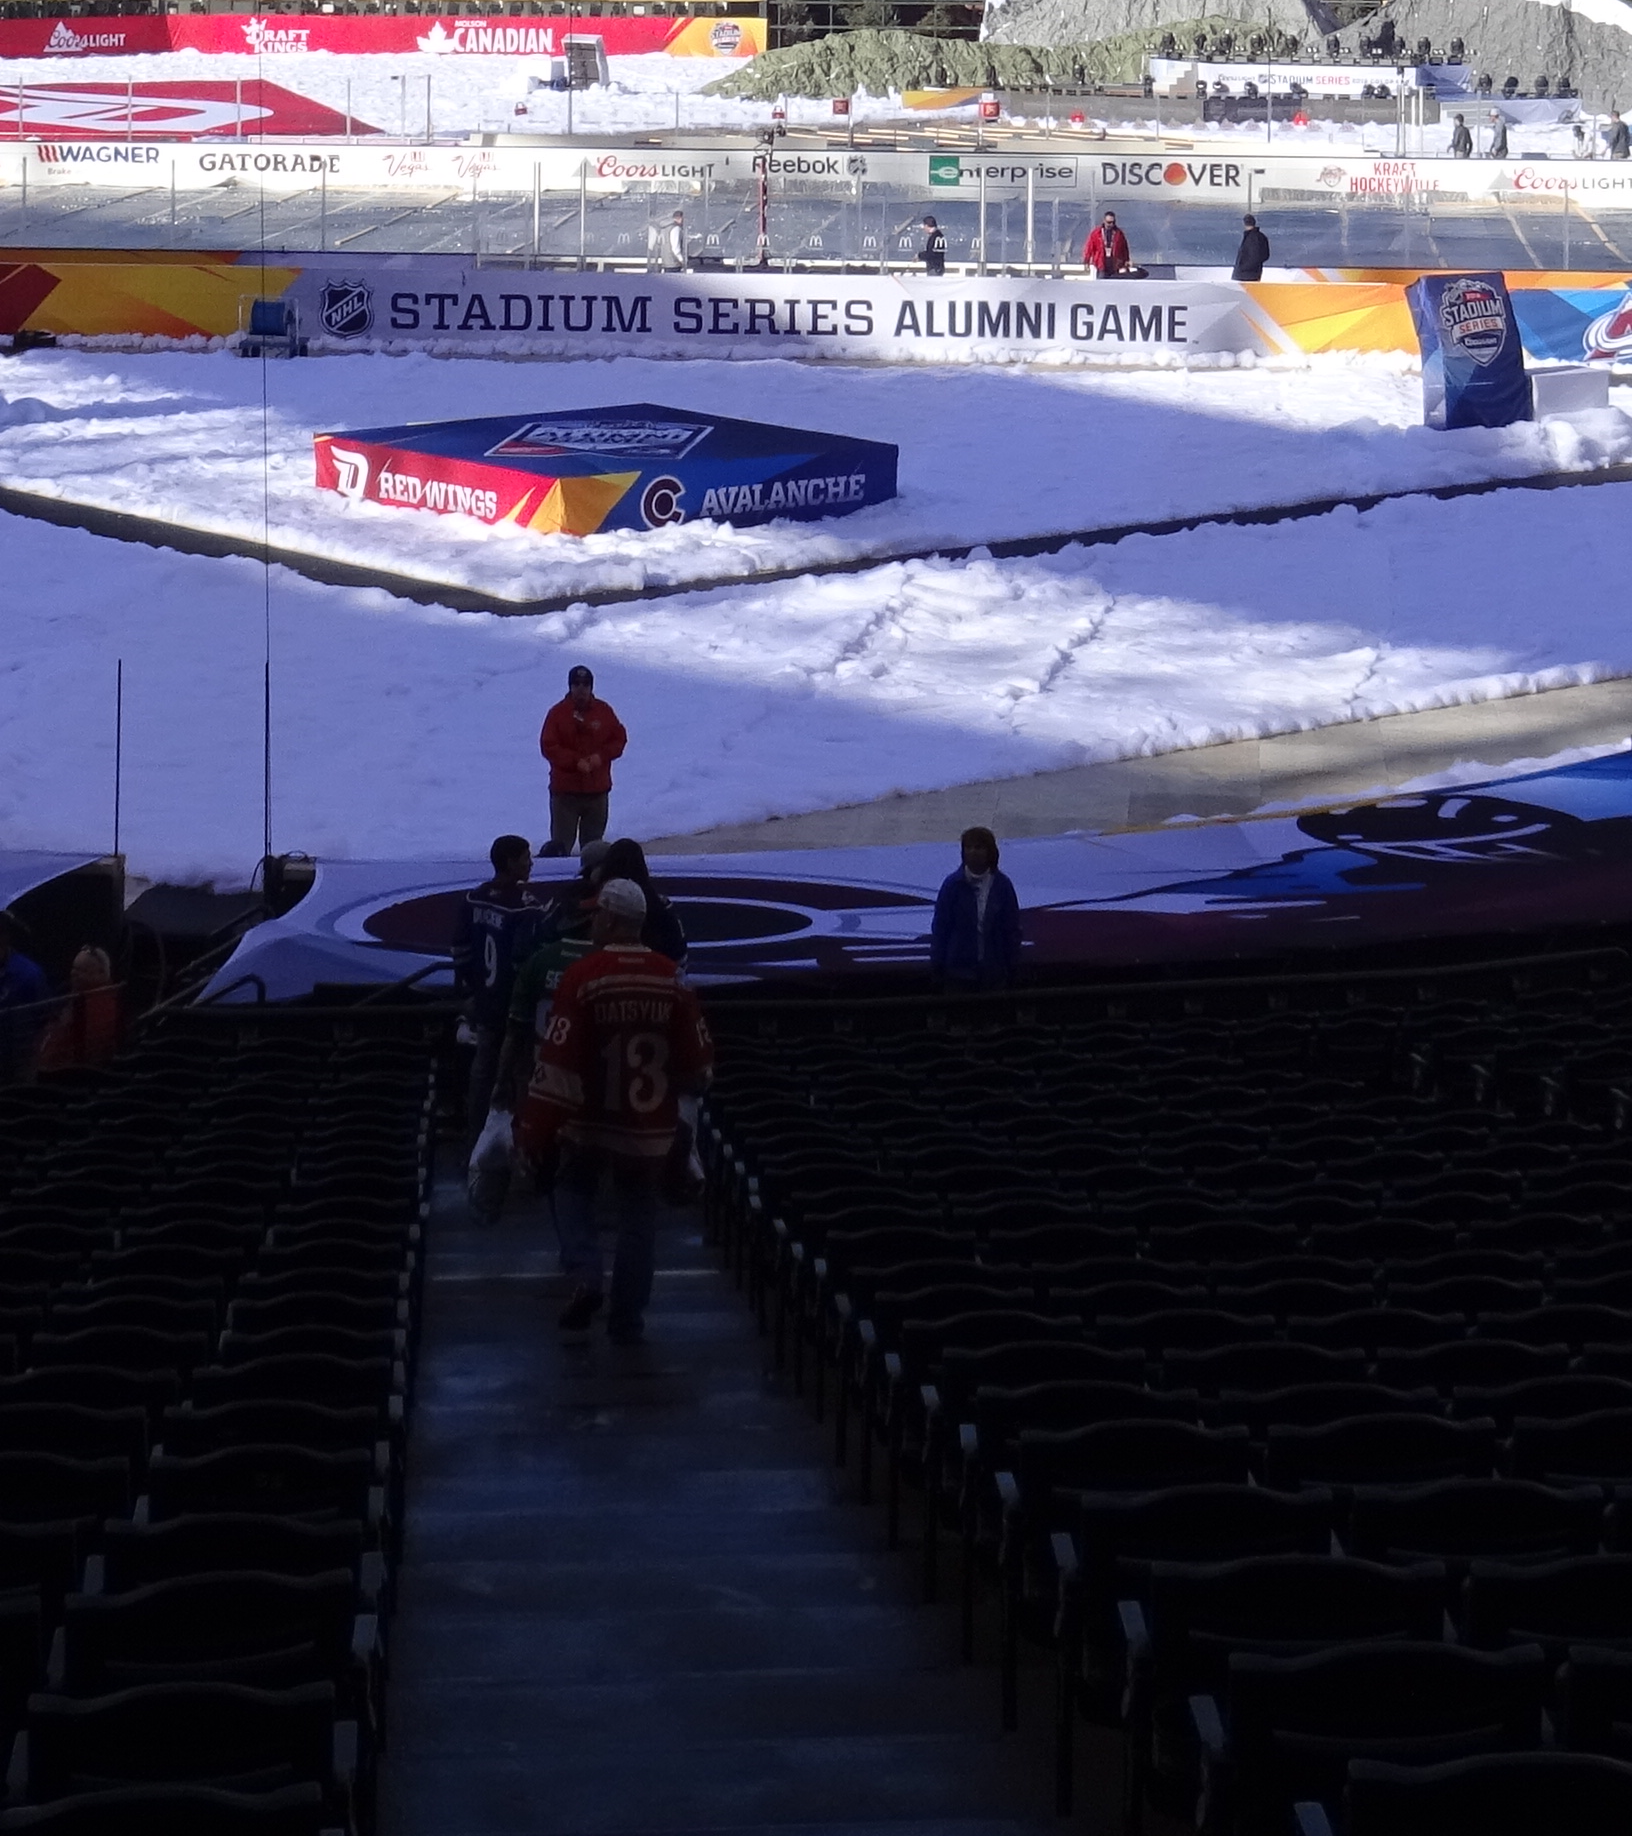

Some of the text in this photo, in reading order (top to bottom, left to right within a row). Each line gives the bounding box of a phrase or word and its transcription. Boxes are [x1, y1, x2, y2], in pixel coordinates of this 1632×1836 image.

[89, 34, 126, 47] LIGHT
[246, 29, 310, 44] DRAFT
[254, 42, 308, 54] KINGS
[453, 28, 555, 53] CANADIAN
[1270, 74, 1351, 86] STADIUM SERIES
[58, 145, 160, 164] WAGNER
[198, 153, 340, 173] GATORADE
[751, 155, 840, 175] Reebok
[597, 155, 714, 179] Coors LIGHT
[1101, 162, 1241, 187] DISCOVER
[1374, 162, 1416, 177] KRAFT
[1513, 167, 1579, 191] Coors
[331, 292, 1189, 344] NHL STADIUM SERIES ALUMNI GAME
[1442, 299, 1504, 323] STADIUM
[1459, 318, 1498, 333] SERIES
[379, 471, 497, 519] RED WINGS
[700, 473, 866, 517] AVALANCHE
[484, 933, 497, 988] 9
[600, 1032, 670, 1113] 13
